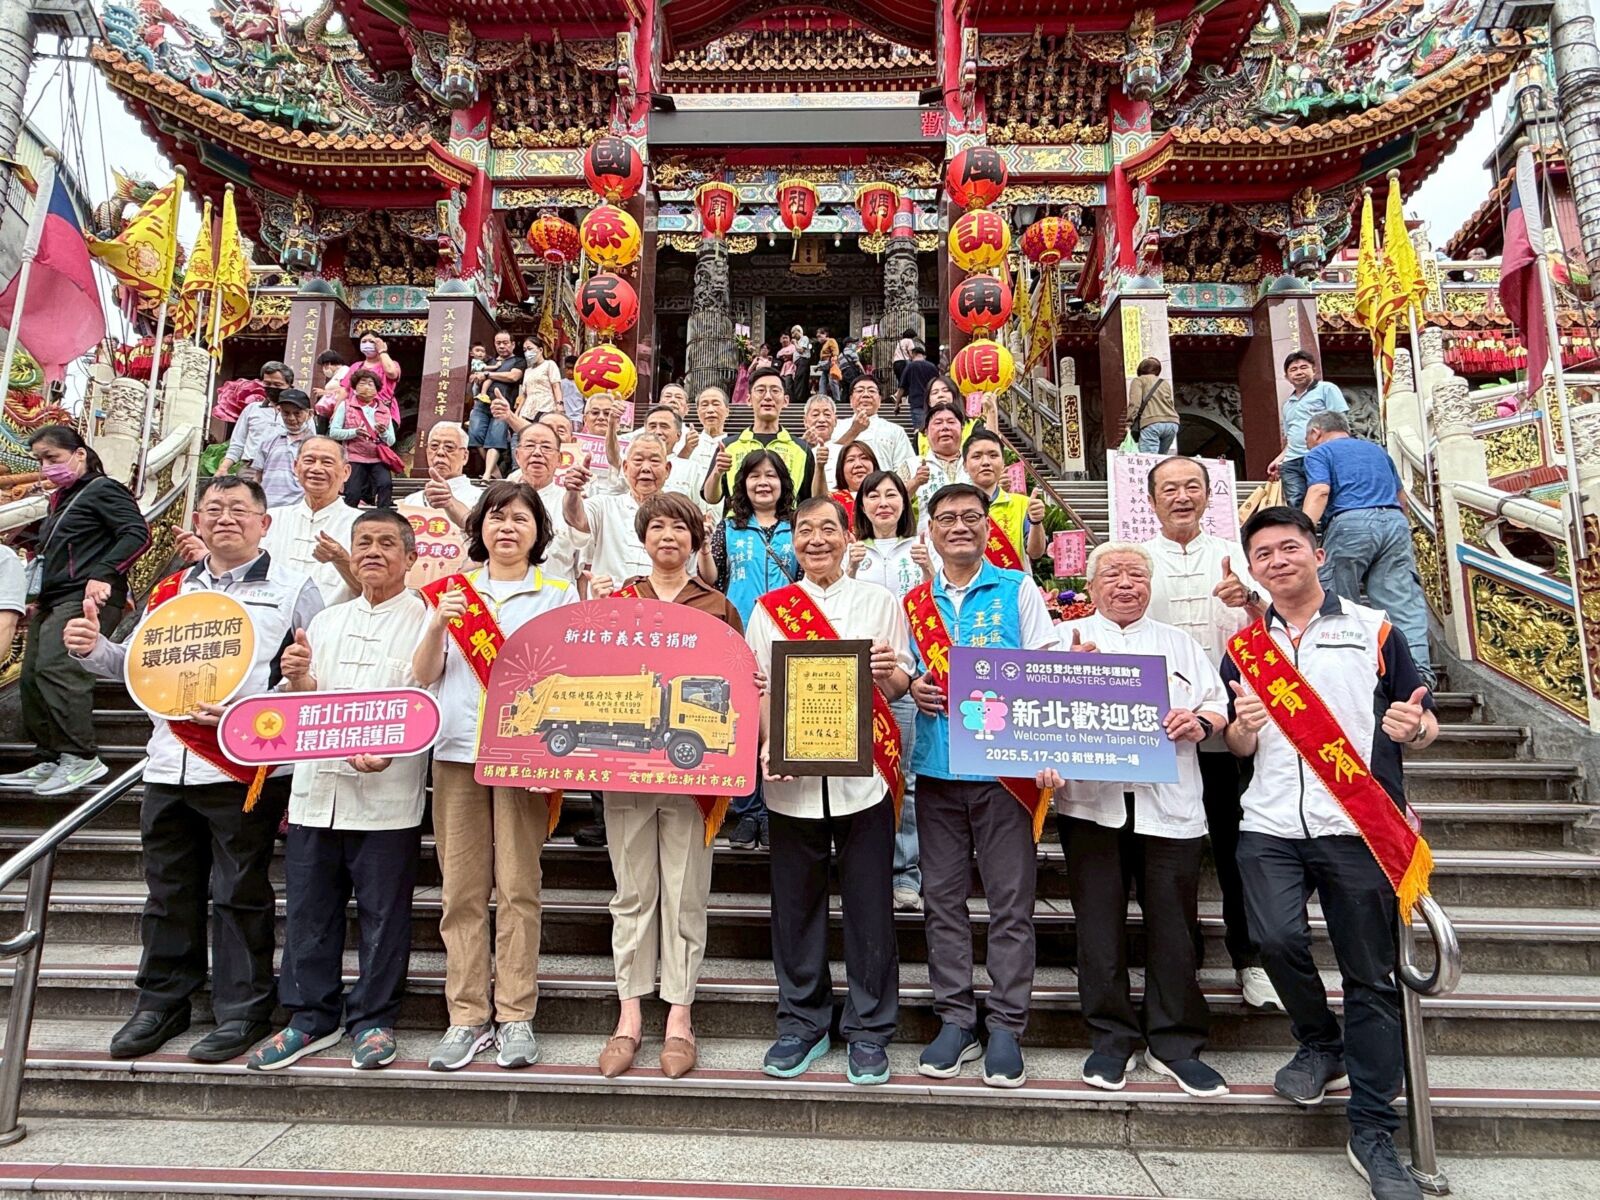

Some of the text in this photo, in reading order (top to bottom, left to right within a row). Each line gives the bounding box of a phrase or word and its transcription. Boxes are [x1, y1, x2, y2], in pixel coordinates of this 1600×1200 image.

[919, 111, 944, 138] 歡
[143, 617, 244, 647] 新北市政府
[564, 629, 698, 649] 新北市義天宮捐贈
[141, 639, 241, 669] 環境保護局
[1026, 675, 1142, 687] WORLD MASTERS GAMES
[298, 699, 409, 727] 新北市政府
[1012, 698, 1160, 732] 新北歡迎您
[295, 724, 406, 752] 環境保護局
[1013, 730, 1160, 748] Welcome to New Taipei City
[986, 749, 1070, 763] 2025.5.17-30
[483, 765, 612, 783] 捐贈單位:新北市義天宮
[628, 771, 747, 788] 受贈單位:新北市政府
